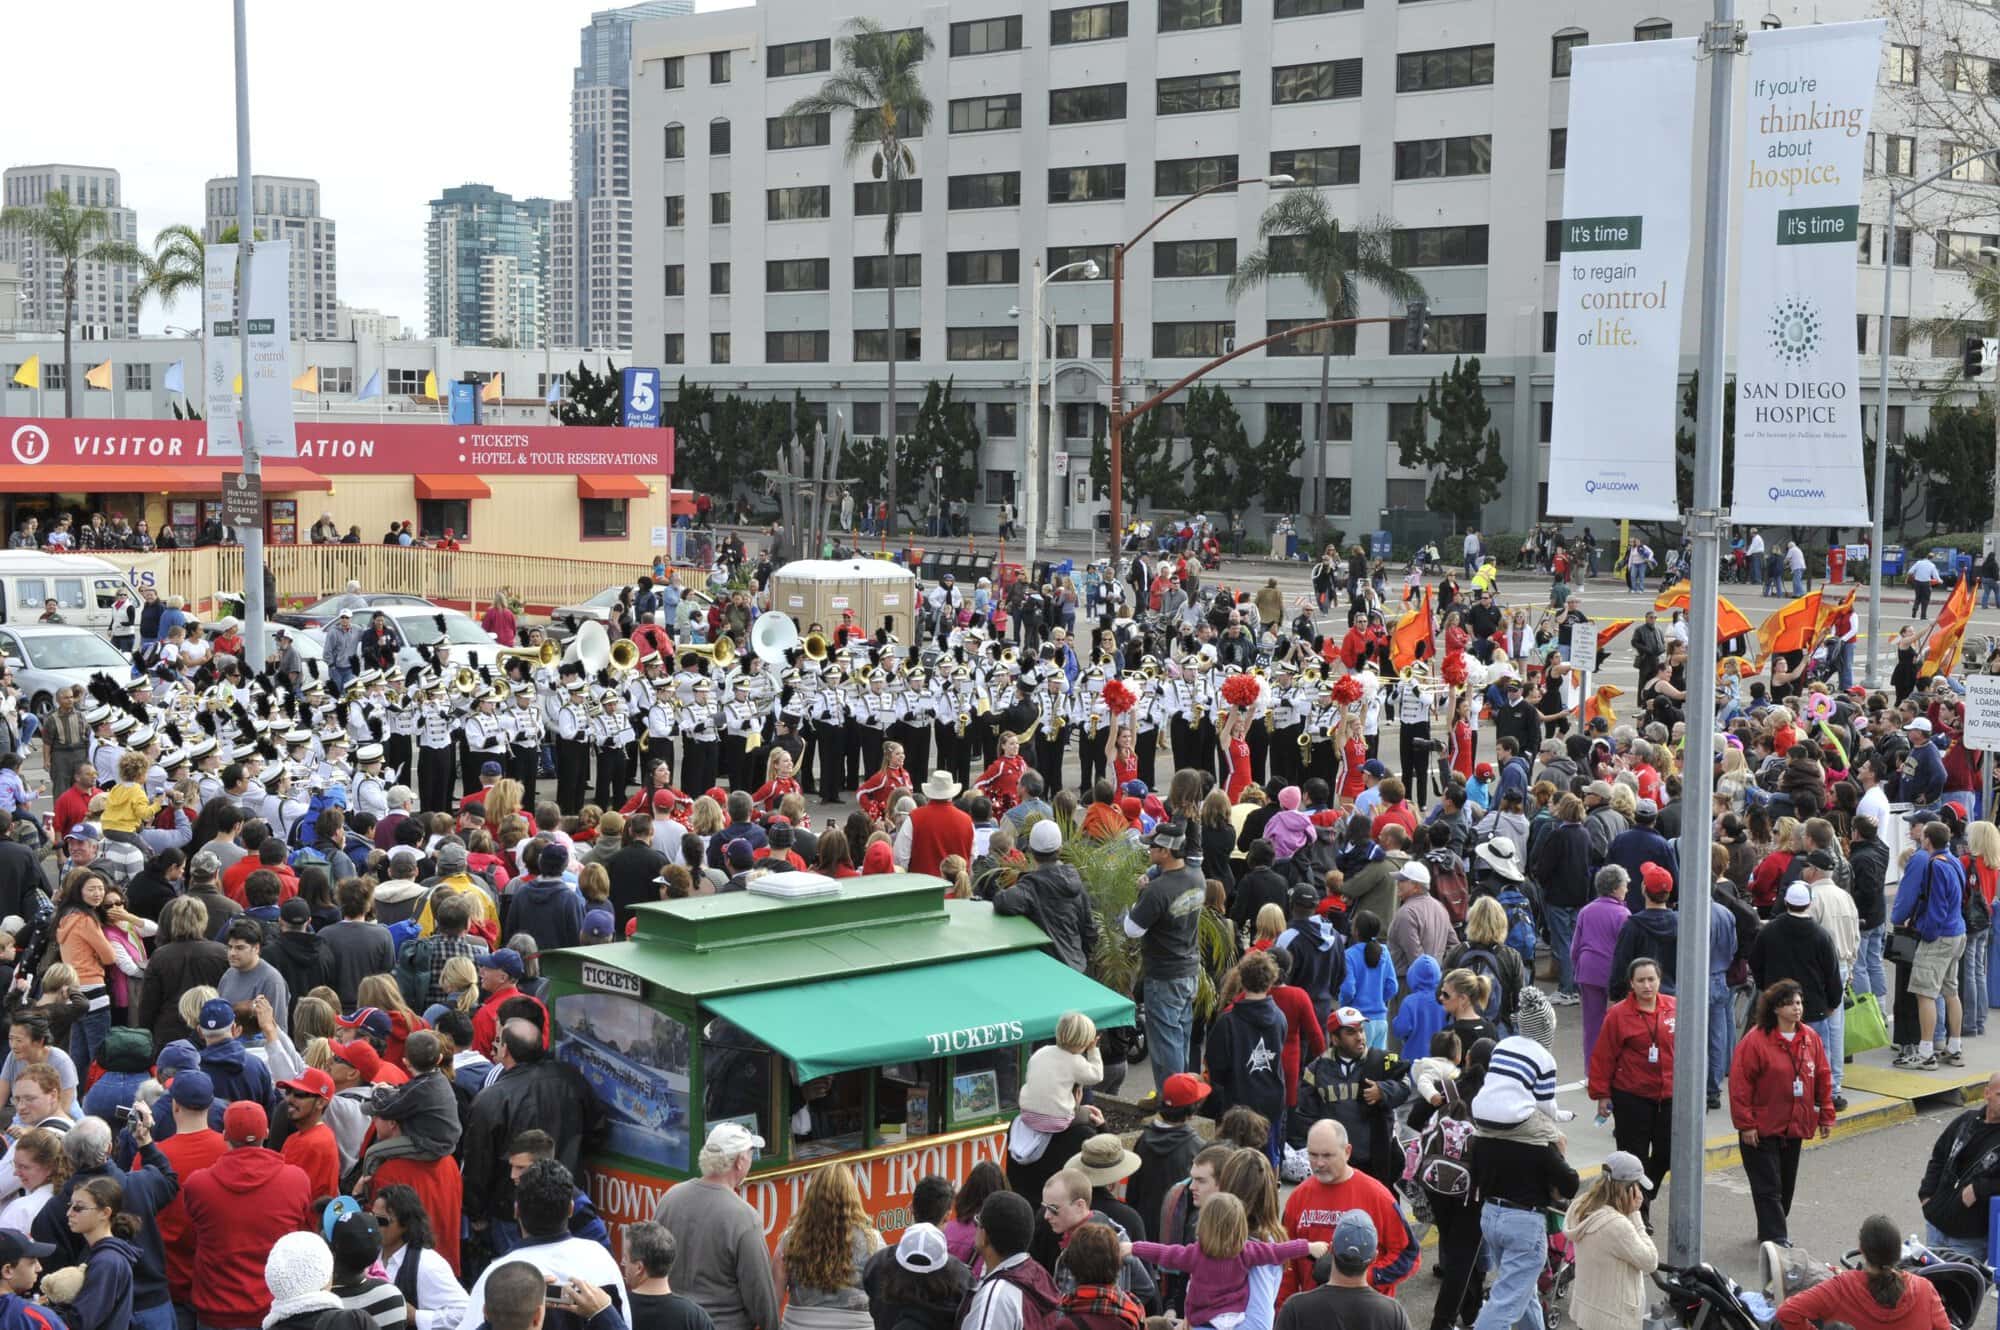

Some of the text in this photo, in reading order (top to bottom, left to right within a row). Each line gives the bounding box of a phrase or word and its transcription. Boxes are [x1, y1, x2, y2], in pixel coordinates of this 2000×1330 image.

[1754, 76, 1817, 100] If you're
[1760, 100, 1864, 138] thinking
[1768, 139, 1812, 158] about
[1747, 159, 1841, 196] hospice,
[1570, 224, 1629, 243] It's time
[1787, 216, 1845, 236] It's time
[1572, 262, 1637, 283] to regain
[1580, 280, 1668, 310] control
[1577, 317, 1638, 346] of life.
[629, 372, 654, 412] 5
[1743, 382, 1846, 400] SAN DIEGO
[1756, 406, 1837, 423] HOSPICE
[73, 437, 183, 456] VISITOR
[197, 438, 375, 457] IATION
[471, 434, 529, 447] TICKETS
[471, 453, 658, 465] HOTEL & TOUR RESERVATIONS
[1585, 480, 1640, 494] QUALCOMM
[1768, 487, 1825, 501] QUALCOMM
[1969, 686, 2000, 696] PASSEN
[1975, 698, 2000, 707] LOADIN
[1967, 719, 1980, 728] NO
[583, 966, 639, 992] TICKETS
[927, 1020, 1024, 1055] TICKETS
[596, 1173, 663, 1222] TOWN
[877, 1208, 913, 1232] CORO
